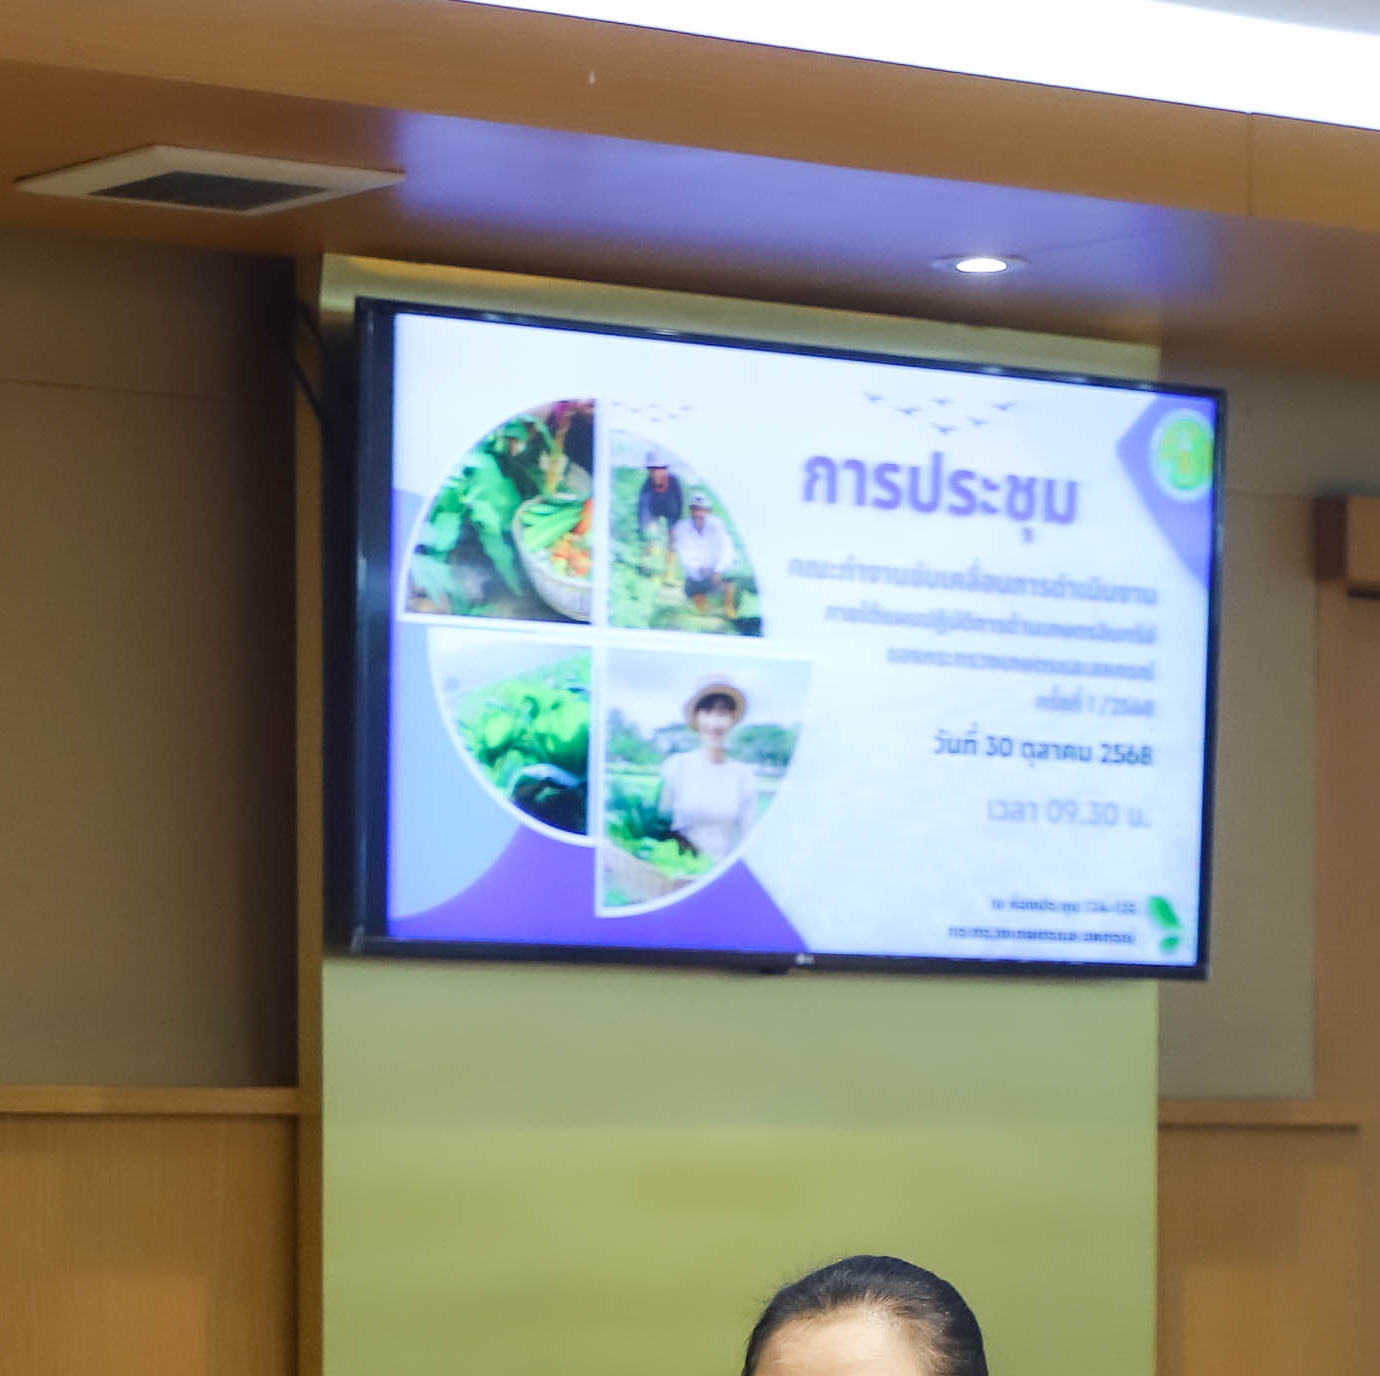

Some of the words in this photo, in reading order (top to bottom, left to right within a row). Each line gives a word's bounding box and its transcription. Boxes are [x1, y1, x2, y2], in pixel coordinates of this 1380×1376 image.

[802, 450, 1078, 543] การประชุม
[933, 720, 979, 755] วันที่
[986, 735, 1014, 757] 30
[1021, 741, 1093, 767] ตุลาคม
[1100, 742, 1154, 765] 2568
[987, 799, 1039, 822] เวลา
[1046, 797, 1119, 826] 09.30
[1127, 804, 1153, 828] น.
